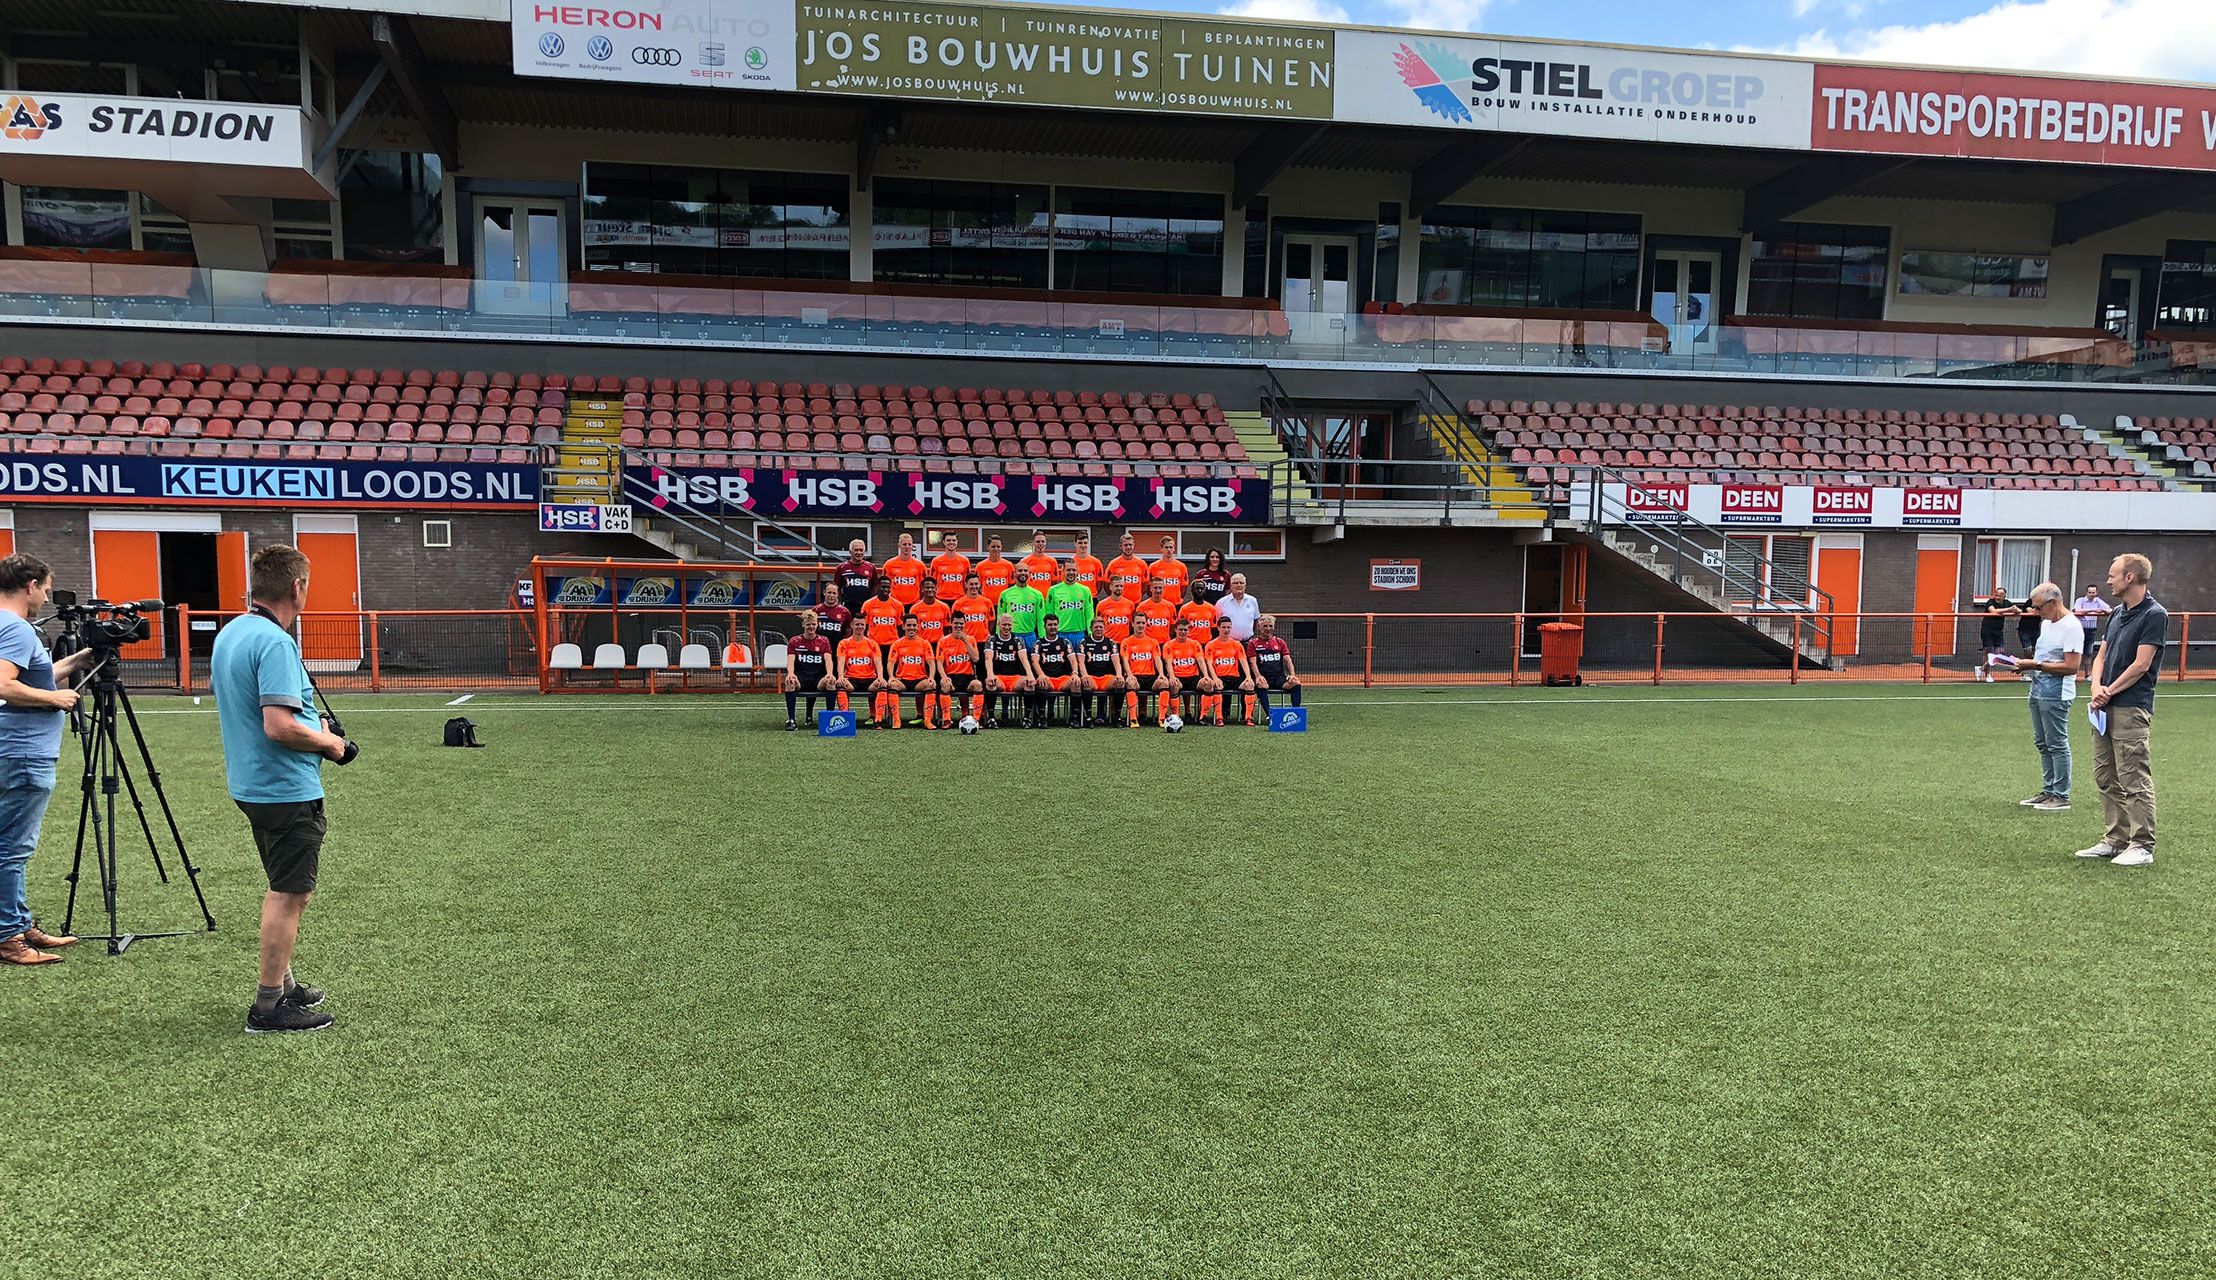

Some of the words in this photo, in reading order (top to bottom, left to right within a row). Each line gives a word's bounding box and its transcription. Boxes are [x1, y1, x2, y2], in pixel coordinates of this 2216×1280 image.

[535, 4, 661, 31] HERON
[671, 14, 770, 37] AUTO
[803, 6, 979, 27] TUINARCHITECTUUR
[1026, 20, 1159, 41] TUINRENOVATIE
[1205, 32, 1325, 50] BEPLANTINGEN
[535, 60, 570, 68] Volkswagen
[803, 30, 881, 65] JOS
[907, 35, 1149, 79] BOUWHUIS
[1173, 53, 1330, 89] TUINEN
[690, 69, 735, 79] SEAT
[837, 74, 1026, 96] WWW.JOSBOUWHUIS.NL
[1471, 57, 1603, 99] STIEL
[1608, 67, 1764, 109] GROEP
[1114, 89, 1293, 111] WWW.JOSBOUWHUIS.NL
[1471, 96, 1521, 110] BOUW
[1531, 101, 1644, 119] INSTALLATIE
[1654, 108, 1758, 125] ONDERHOUD
[1821, 87, 2184, 148] TRANSPORTBEDRIJF
[88, 105, 274, 142] STADION
[588, 402, 607, 410] HSB
[585, 420, 604, 428] HSB
[580, 457, 599, 466] HSB
[0, 463, 135, 494] DS.NL
[164, 466, 329, 498] KEUKEN
[341, 469, 534, 501] LOODS.NL
[658, 475, 751, 504] HSB
[788, 478, 877, 507] HSB
[914, 481, 1000, 510] HSB
[1037, 484, 1121, 512] HSB
[1155, 486, 1236, 513] HSB
[1630, 489, 1685, 506] DEEN
[1725, 490, 1779, 508] DEEN
[1817, 491, 1869, 509] DEEN
[1907, 493, 1958, 511] DEEN
[604, 507, 629, 518] VAK
[547, 510, 594, 526] HSB
[604, 519, 629, 530] C+D
[894, 576, 916, 585] HSB
[942, 573, 963, 581] HSB
[986, 577, 1007, 586] HSB
[1030, 572, 1051, 581] HSB
[846, 578, 869, 587] HSB
[570, 585, 588, 596] AA
[639, 586, 657, 597] AA
[708, 587, 725, 598] AA
[776, 588, 792, 598] AA
[1011, 603, 1034, 612] HSB
[1060, 601, 1083, 609] HSB
[873, 616, 895, 625] HSB
[964, 613, 986, 622] HSB
[1107, 616, 1129, 624] HSB
[1147, 618, 1168, 626] HSB
[819, 622, 842, 631] HSB
[920, 621, 941, 629] HSB
[1190, 620, 1211, 628] HSB
[798, 654, 822, 664] HSB
[848, 656, 871, 665] HSB
[901, 655, 922, 665] HSB
[949, 654, 970, 663] HSB
[997, 652, 1015, 662] HSB
[1043, 653, 1064, 663] HSB
[1089, 653, 1110, 662] HSB
[1131, 652, 1152, 660] HSB
[1259, 652, 1281, 662] HSB
[1174, 657, 1195, 666] HSB
[1215, 657, 1236, 666] HSB
